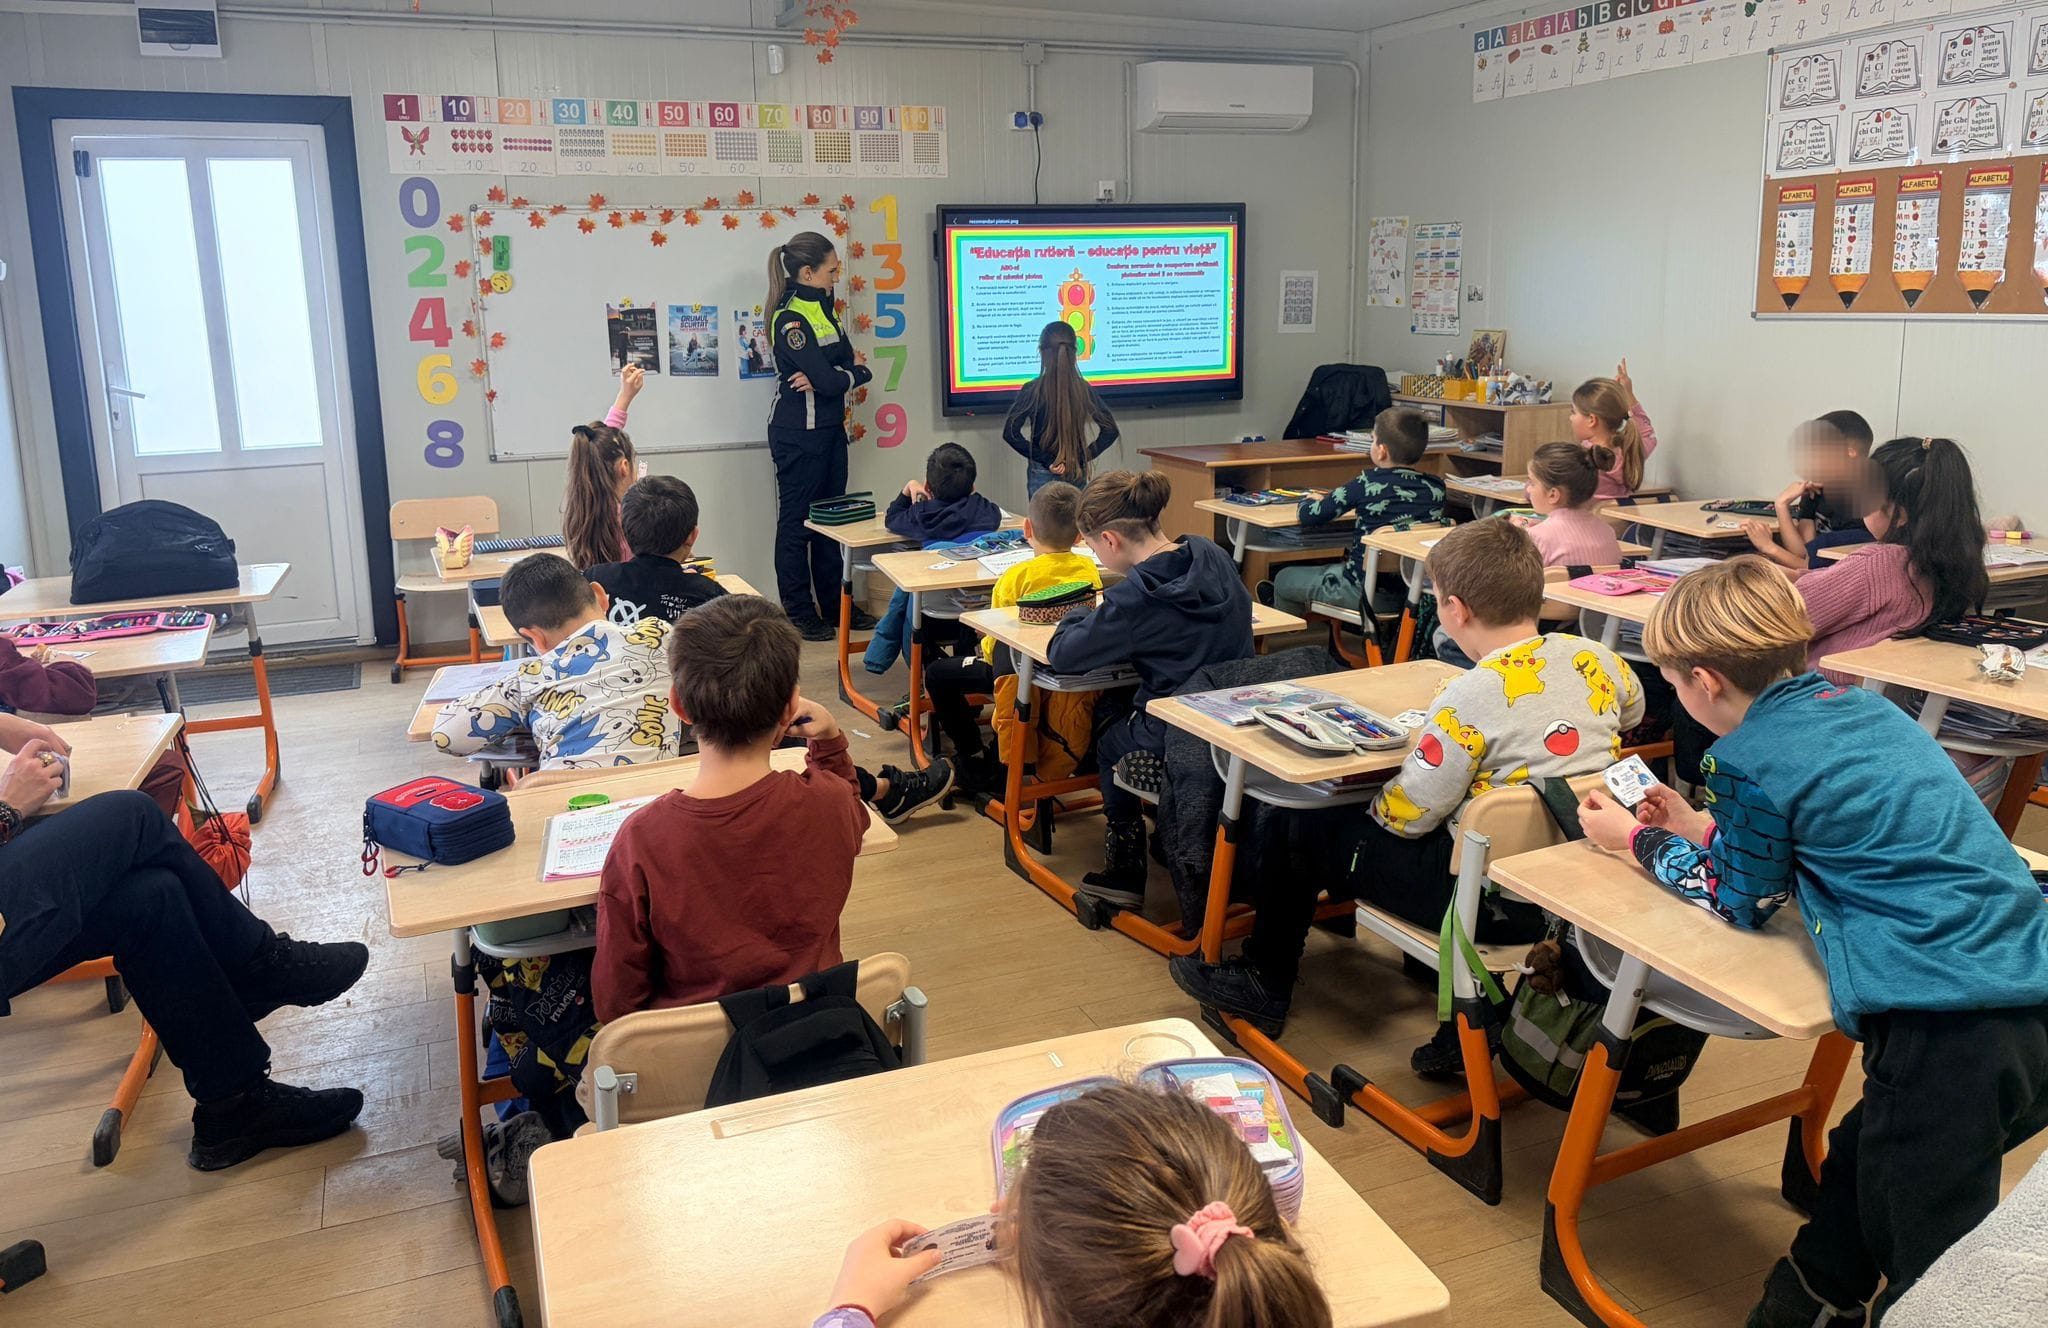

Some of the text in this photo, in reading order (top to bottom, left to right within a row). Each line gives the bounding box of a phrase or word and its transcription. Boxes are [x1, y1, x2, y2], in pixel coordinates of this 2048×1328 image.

[1478, 37, 1484, 49] a
[1494, 29, 1504, 47] A
[1544, 20, 1551, 35] â
[1561, 12, 1570, 32] Â
[1578, 10, 1587, 27] b
[1599, 3, 1611, 21] B
[1617, 3, 1626, 17] c
[1865, 62, 1883, 72] ci Ci
[1948, 49, 1972, 61] ge Ge
[397, 98, 926, 125] 1 10 20 30 40 50 60 70 80 90 100
[466, 160, 483, 171] 10
[521, 162, 537, 173] 20
[576, 161, 592, 172] 30
[628, 162, 644, 173] 40
[679, 162, 695, 173] 50
[730, 162, 746, 173] 60
[778, 165, 794, 174] 70
[827, 164, 841, 174] 80
[874, 165, 887, 175] 90
[917, 165, 937, 175] 100
[1840, 185, 1872, 194] ALFABETUL
[1902, 179, 1938, 188] ALFABETUL
[1970, 173, 2009, 183] ALFABETUL
[399, 177, 441, 229] 0
[869, 194, 898, 241] 1
[1783, 191, 1813, 200] ALFABETUL
[403, 235, 448, 288] 2
[872, 243, 906, 291] 3
[1034, 245, 1075, 258] rutieră
[1142, 244, 1180, 258] pentru
[408, 297, 453, 348] 4
[875, 293, 906, 339] 5
[417, 353, 459, 405] 6
[873, 345, 908, 392] 7
[423, 419, 465, 469] 8
[875, 403, 908, 448] 9
[630, 695, 669, 749] SONIC
